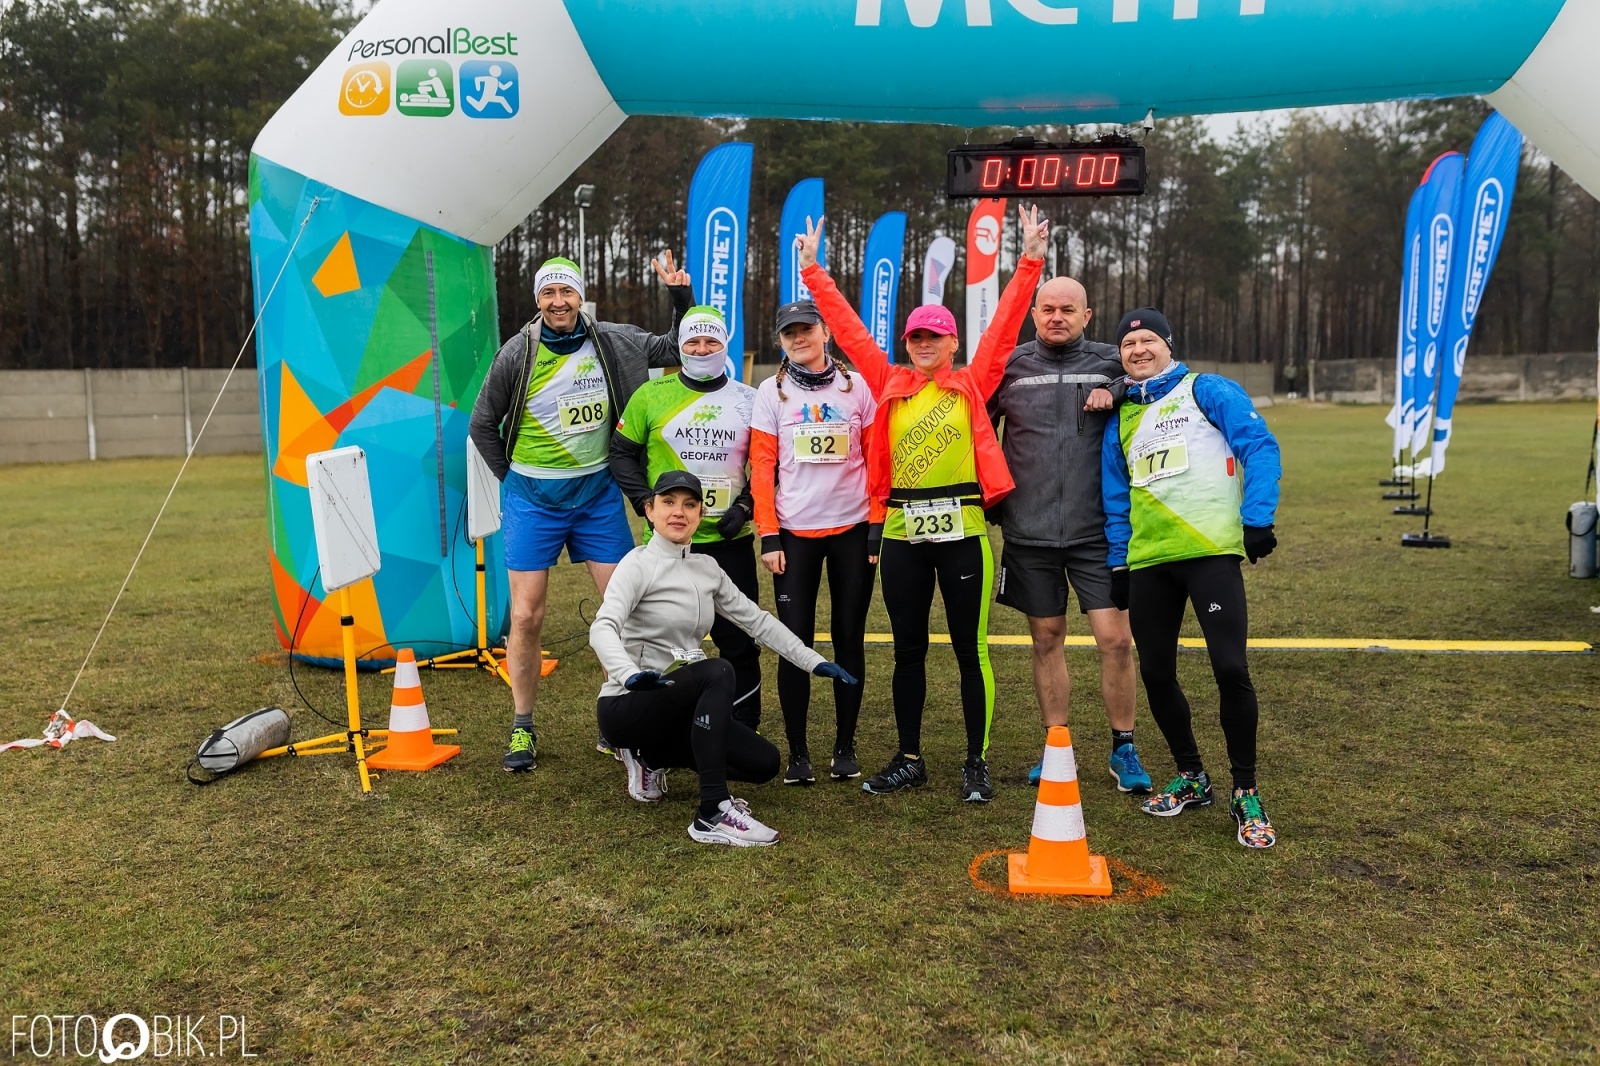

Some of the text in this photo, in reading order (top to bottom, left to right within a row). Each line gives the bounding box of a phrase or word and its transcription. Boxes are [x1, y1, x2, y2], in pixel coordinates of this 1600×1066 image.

[347, 26, 519, 62] PersonalBest
[982, 155, 1120, 188] 0:00:00
[710, 218, 731, 318] AFAMET
[1431, 223, 1449, 325] RAFAMET
[876, 266, 890, 348] RAFAMET
[568, 402, 604, 426] 208
[1154, 416, 1189, 430] AKTYWNI
[674, 427, 736, 442] AKTYWNI
[688, 438, 724, 447] LYSKI
[810, 435, 836, 455] 82
[680, 451, 729, 462] GEOFART
[704, 489, 717, 508] 5
[913, 513, 954, 536] 233
